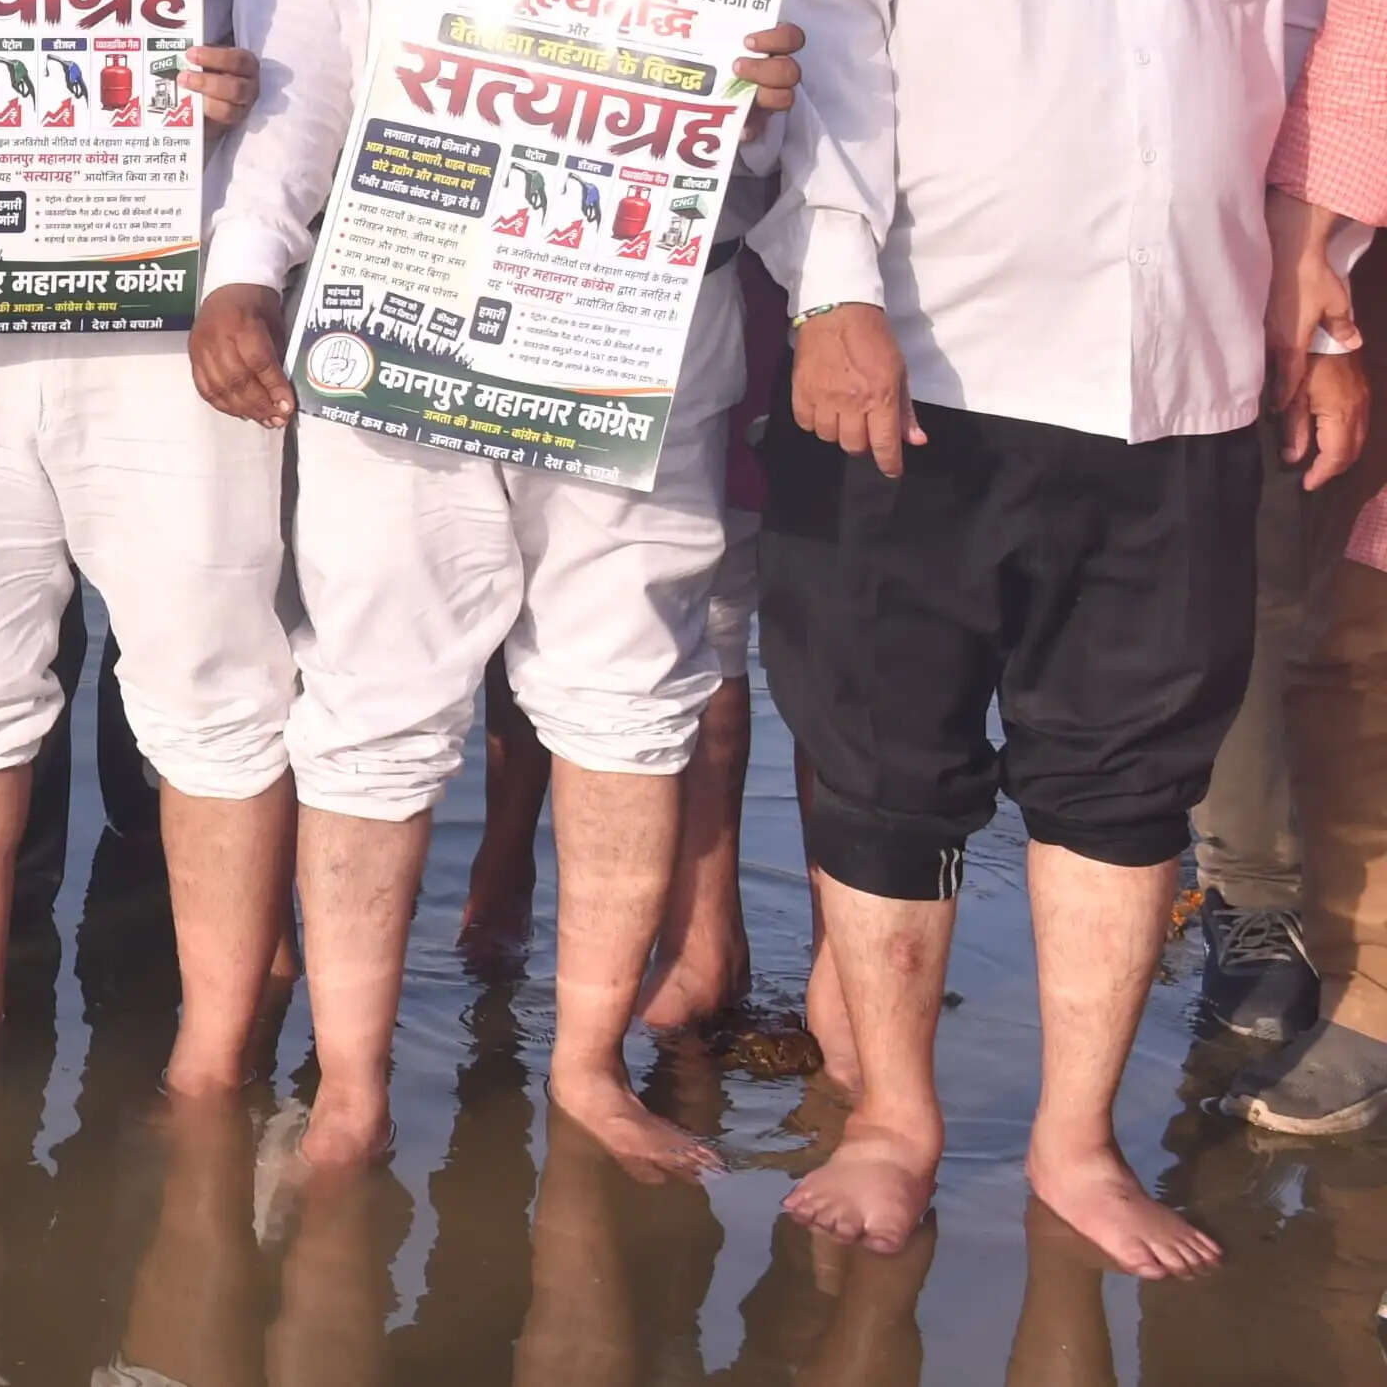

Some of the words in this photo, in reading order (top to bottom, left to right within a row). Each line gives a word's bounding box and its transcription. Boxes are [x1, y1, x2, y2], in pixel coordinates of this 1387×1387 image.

[539, 36, 611, 70] महंगाई
[616, 48, 639, 75] के
[642, 54, 706, 91] विरुद्ध
[395, 40, 738, 170] सत्याग्रह
[11, 270, 110, 296] महानगर
[115, 265, 186, 292] कांग्रेस
[13, 303, 44, 312] आवाज
[55, 301, 83, 312] कांग्रेस
[85, 300, 95, 311] के
[97, 302, 117, 311] साथ
[378, 360, 473, 413] कानपुर
[474, 382, 572, 426] महानगर
[578, 400, 654, 442] कांग्रेस
